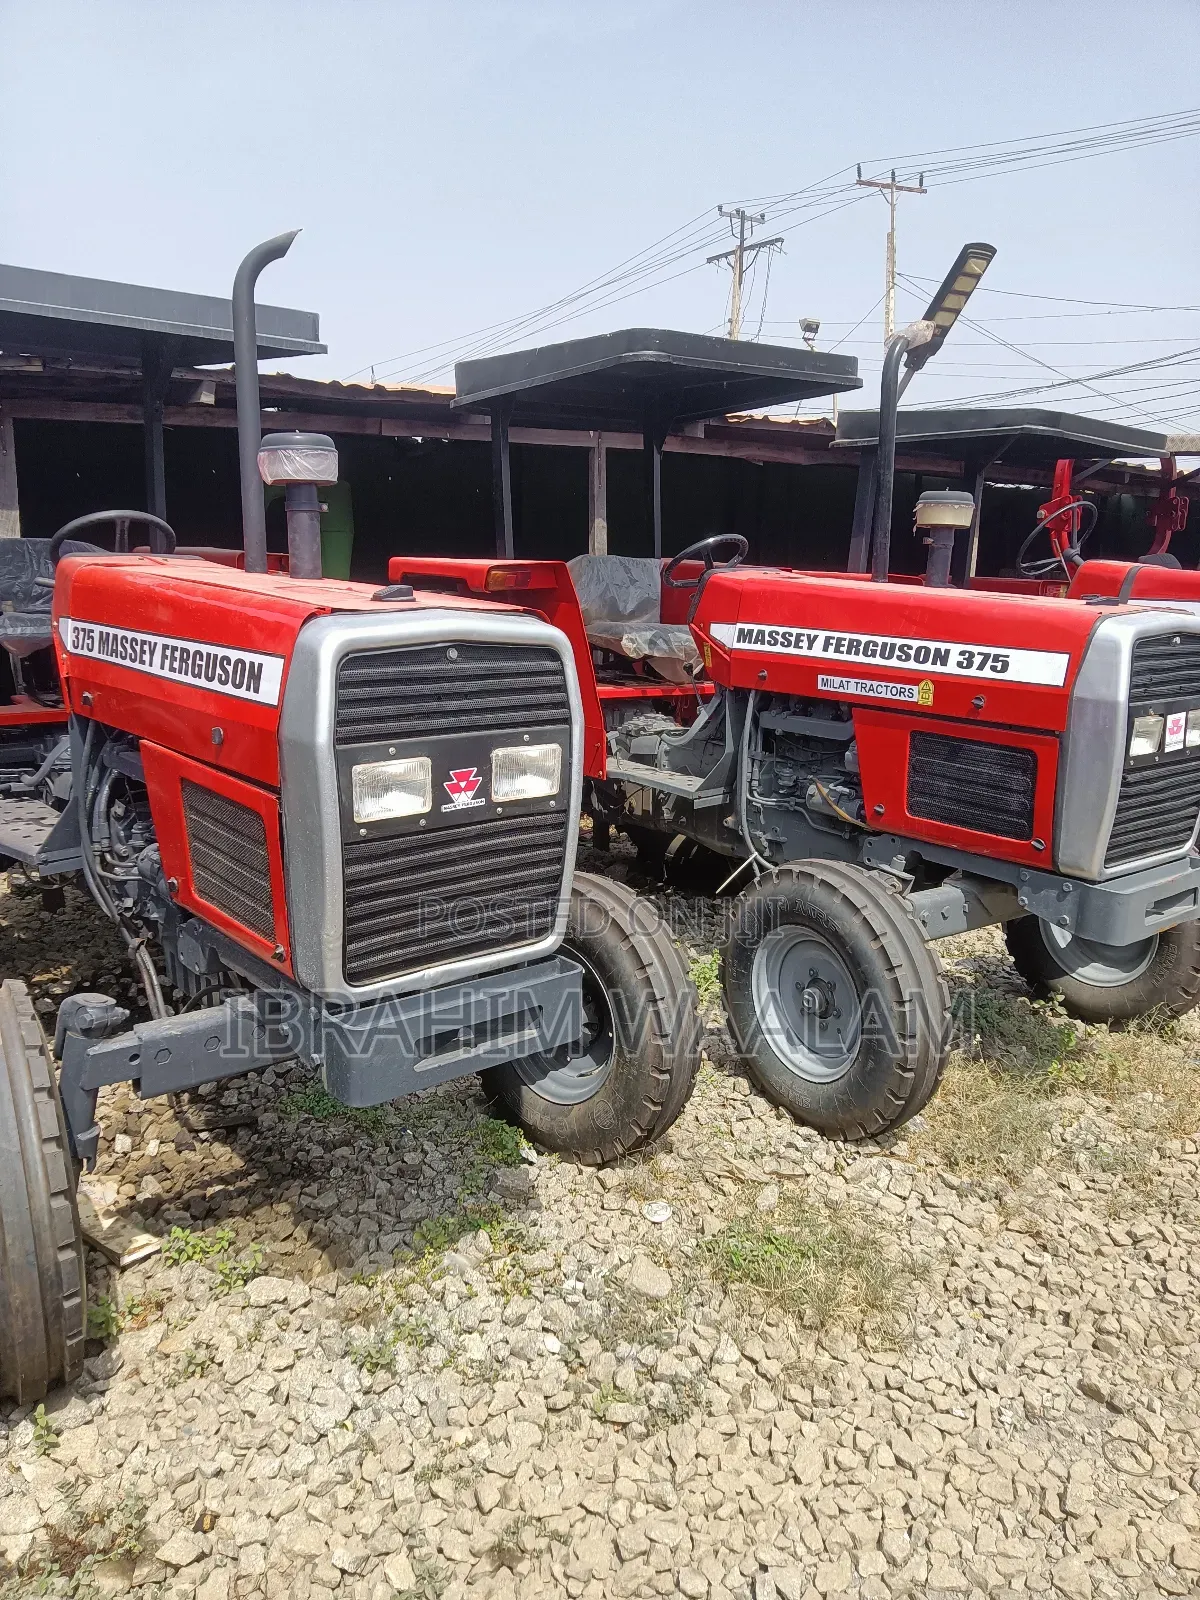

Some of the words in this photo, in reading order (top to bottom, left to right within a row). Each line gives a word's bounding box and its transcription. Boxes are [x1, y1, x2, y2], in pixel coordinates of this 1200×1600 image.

[72, 626, 95, 652] 375
[98, 631, 158, 668] MASSEY
[160, 644, 264, 694] FERGUSON
[736, 628, 819, 651] MASSEY
[822, 635, 951, 667] FERGUSON
[956, 650, 1010, 674] 375
[821, 678, 851, 691] MILAT
[854, 681, 915, 699] TRACTORS
